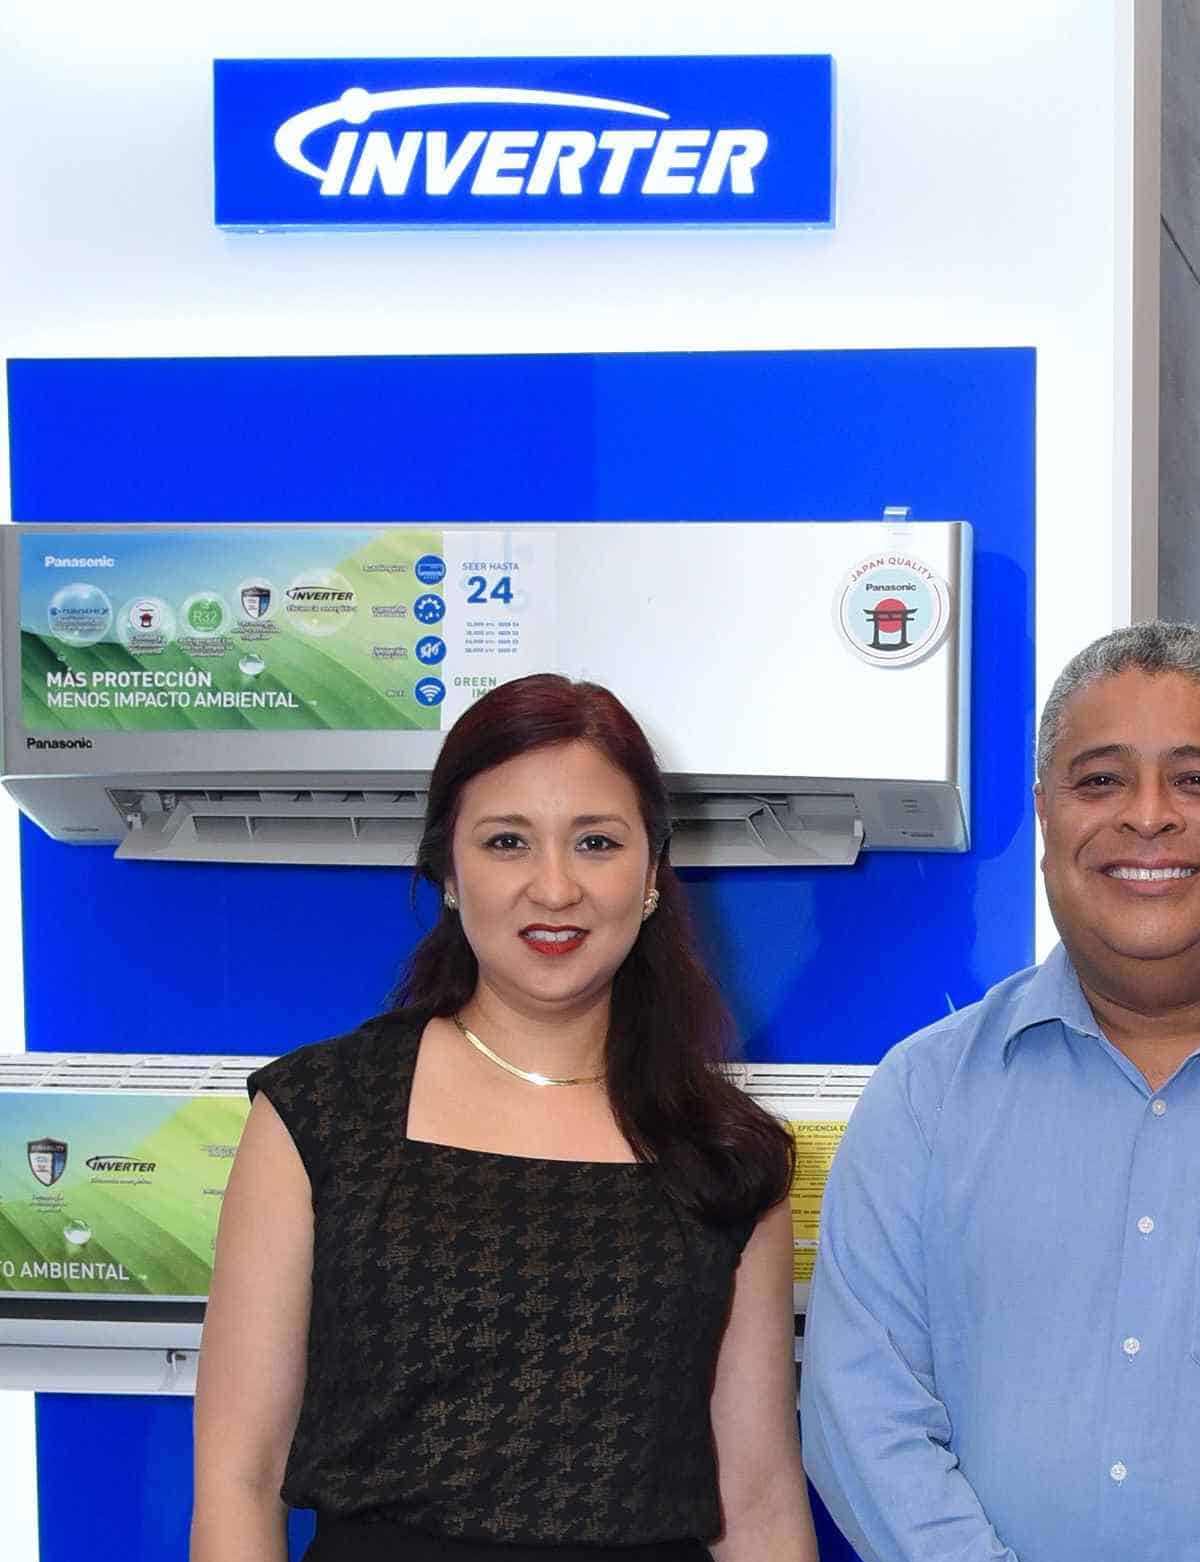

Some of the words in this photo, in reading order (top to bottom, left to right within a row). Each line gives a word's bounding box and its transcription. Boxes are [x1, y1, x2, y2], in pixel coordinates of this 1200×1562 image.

[320, 88, 769, 196] INVERTER
[44, 555, 115, 568] Panasonic
[462, 562, 487, 571] SEER
[489, 562, 520, 571] HASTA
[850, 557, 885, 583] JAPAN
[888, 556, 935, 581] QUALITY
[292, 587, 354, 601] INVERTER
[467, 575, 514, 604] 24
[865, 583, 917, 591] Panasonic
[47, 667, 86, 688] MÁS
[92, 666, 213, 688] PROTECCIÓN
[454, 676, 497, 687] GREEN
[47, 691, 110, 708] MENOS
[114, 691, 189, 708] IMPACTO
[193, 691, 299, 708] AMBIENTAL
[26, 736, 93, 750] Panasonic
[92, 1156, 156, 1173] INVERTER
[21, 1261, 129, 1281] AMBIENTAL
